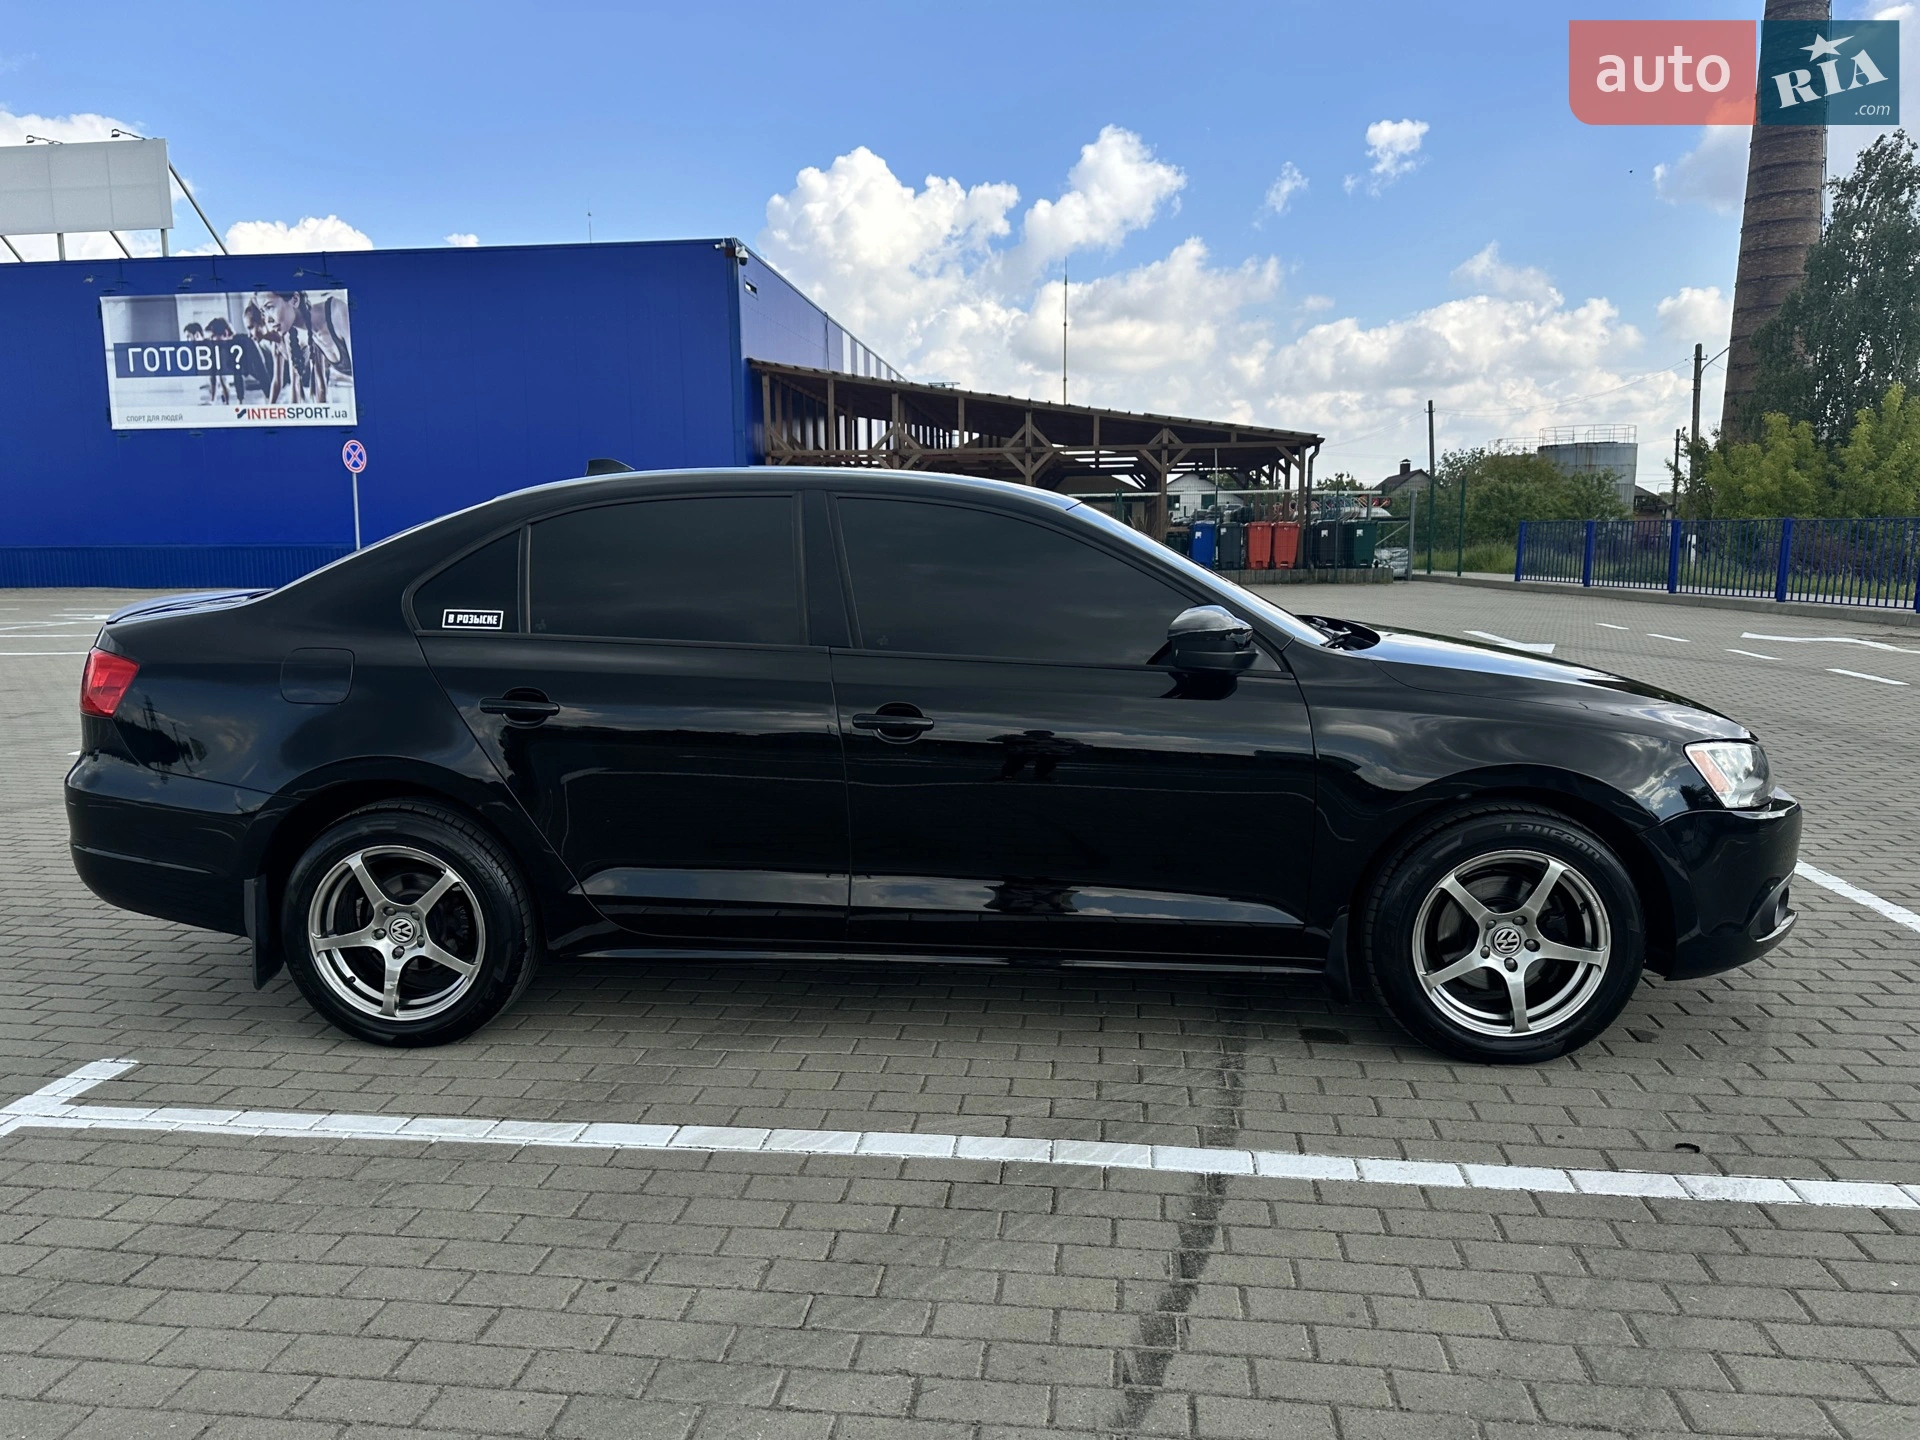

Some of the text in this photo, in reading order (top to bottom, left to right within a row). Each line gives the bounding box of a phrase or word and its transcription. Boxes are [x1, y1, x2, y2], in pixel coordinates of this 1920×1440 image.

[127, 344, 243, 372] ГОТОВІ ?
[147, 414, 160, 423] ДЛЯ
[161, 413, 183, 422] ЛЮДЕЙ
[247, 407, 348, 420] INTERSPORT.ua
[447, 613, 499, 625] В РОЗЫСКЕ
